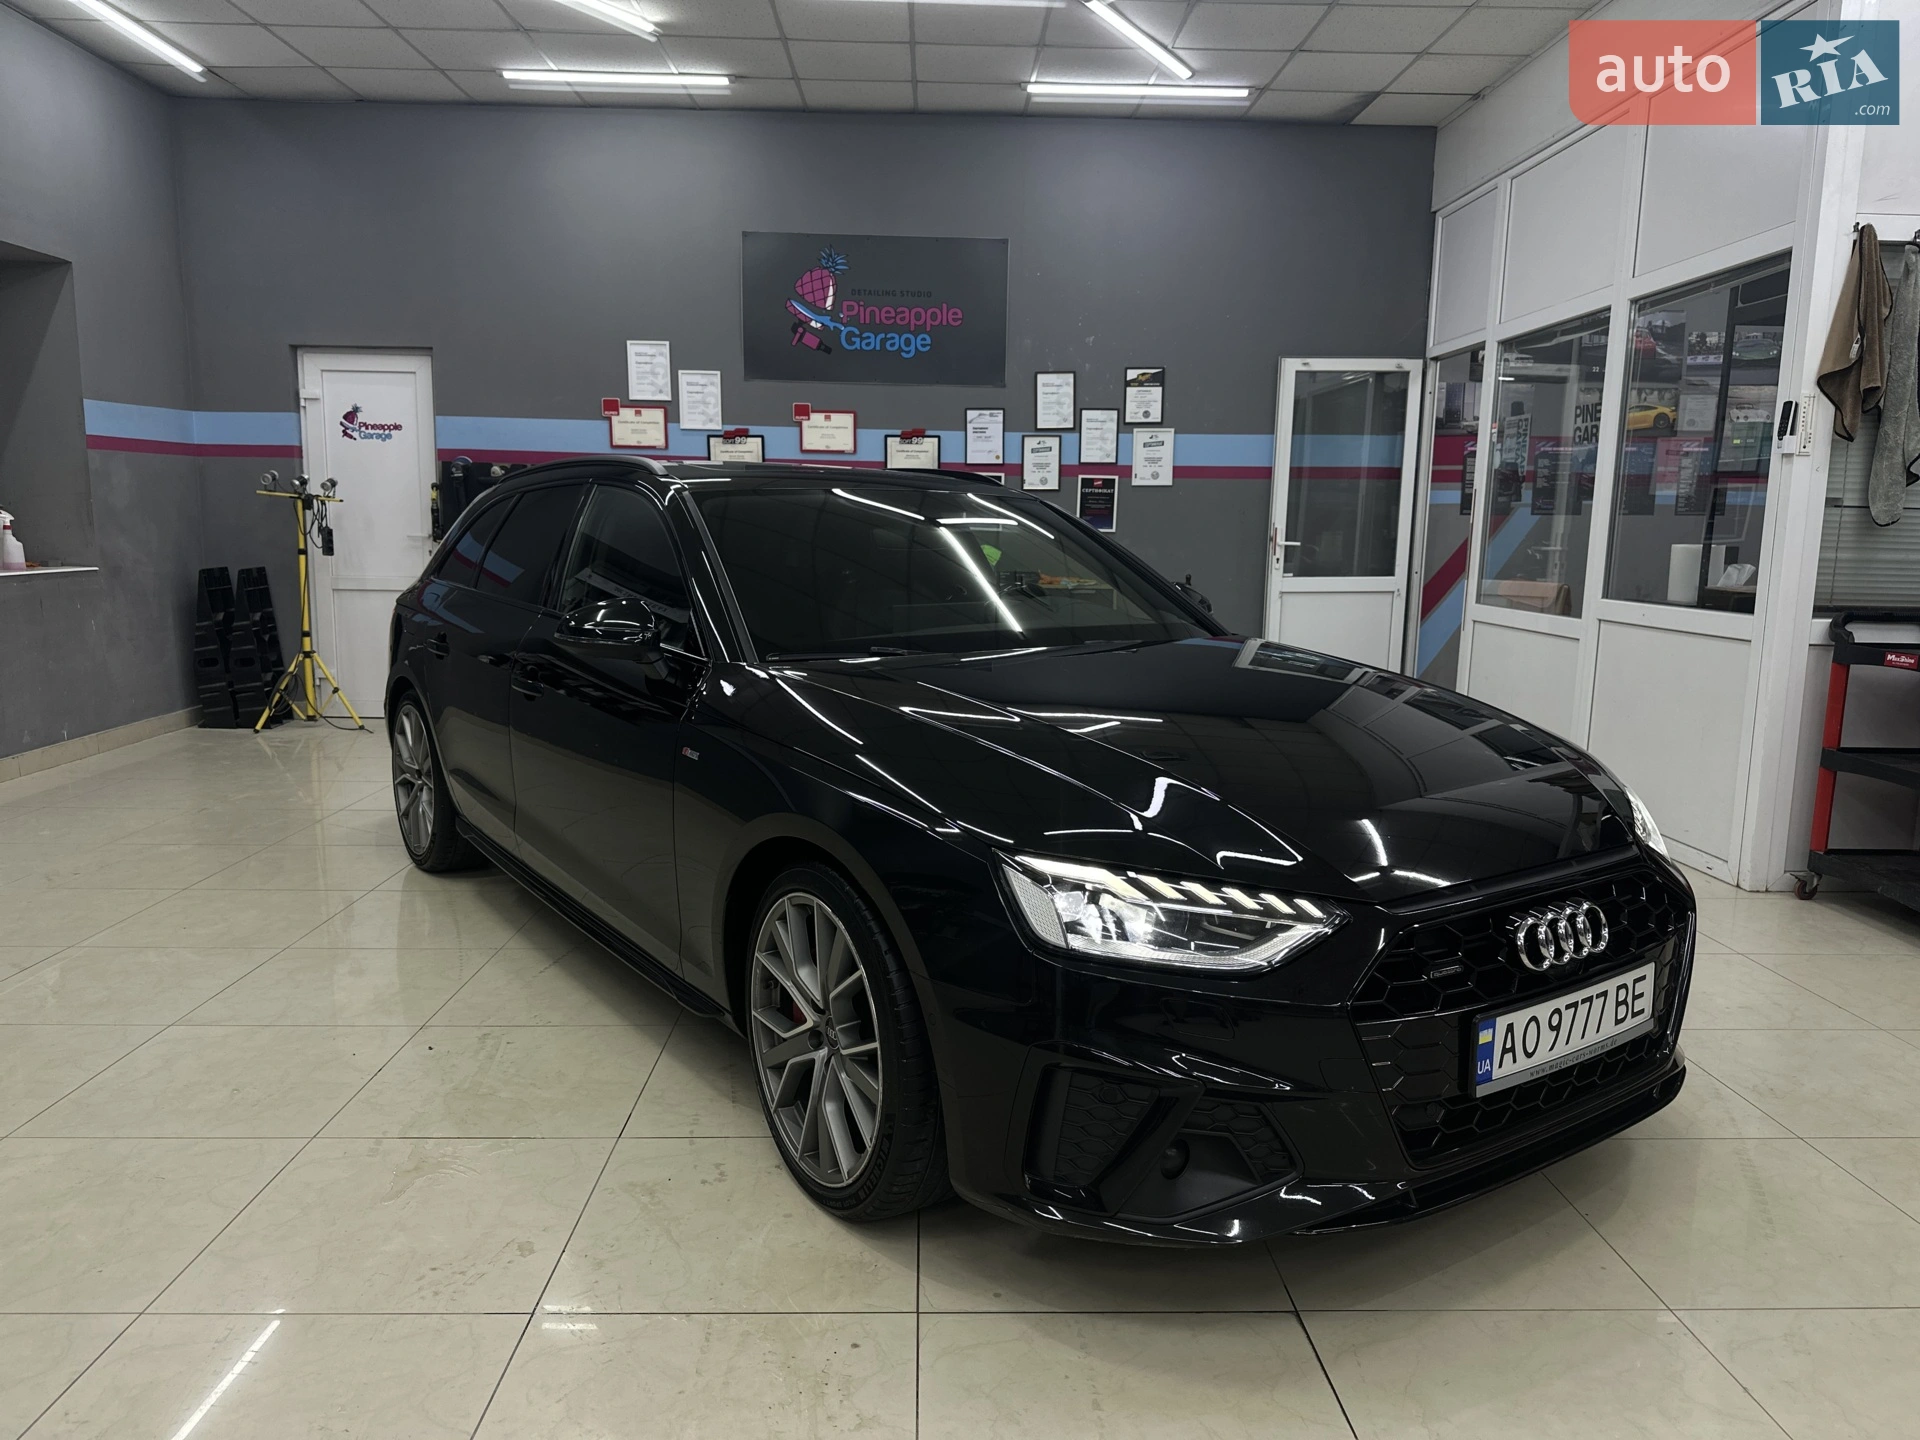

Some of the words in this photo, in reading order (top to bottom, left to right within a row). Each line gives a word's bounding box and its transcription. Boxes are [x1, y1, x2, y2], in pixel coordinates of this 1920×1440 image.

[851, 288, 898, 297] DETAILING
[900, 290, 933, 299] STUDIO
[841, 300, 963, 331] Pineapple
[840, 326, 932, 359] Garage
[358, 421, 403, 432] Pineapple
[359, 431, 393, 442] Garage
[1498, 1015, 1541, 1069] AO
[1548, 989, 1609, 1052] 9777
[1614, 974, 1647, 1026] BE
[1477, 1059, 1491, 1075] UA
[1529, 1037, 1618, 1078] www.magic-cars-worms.de
[858, 1136, 890, 1201] MICHELIN
